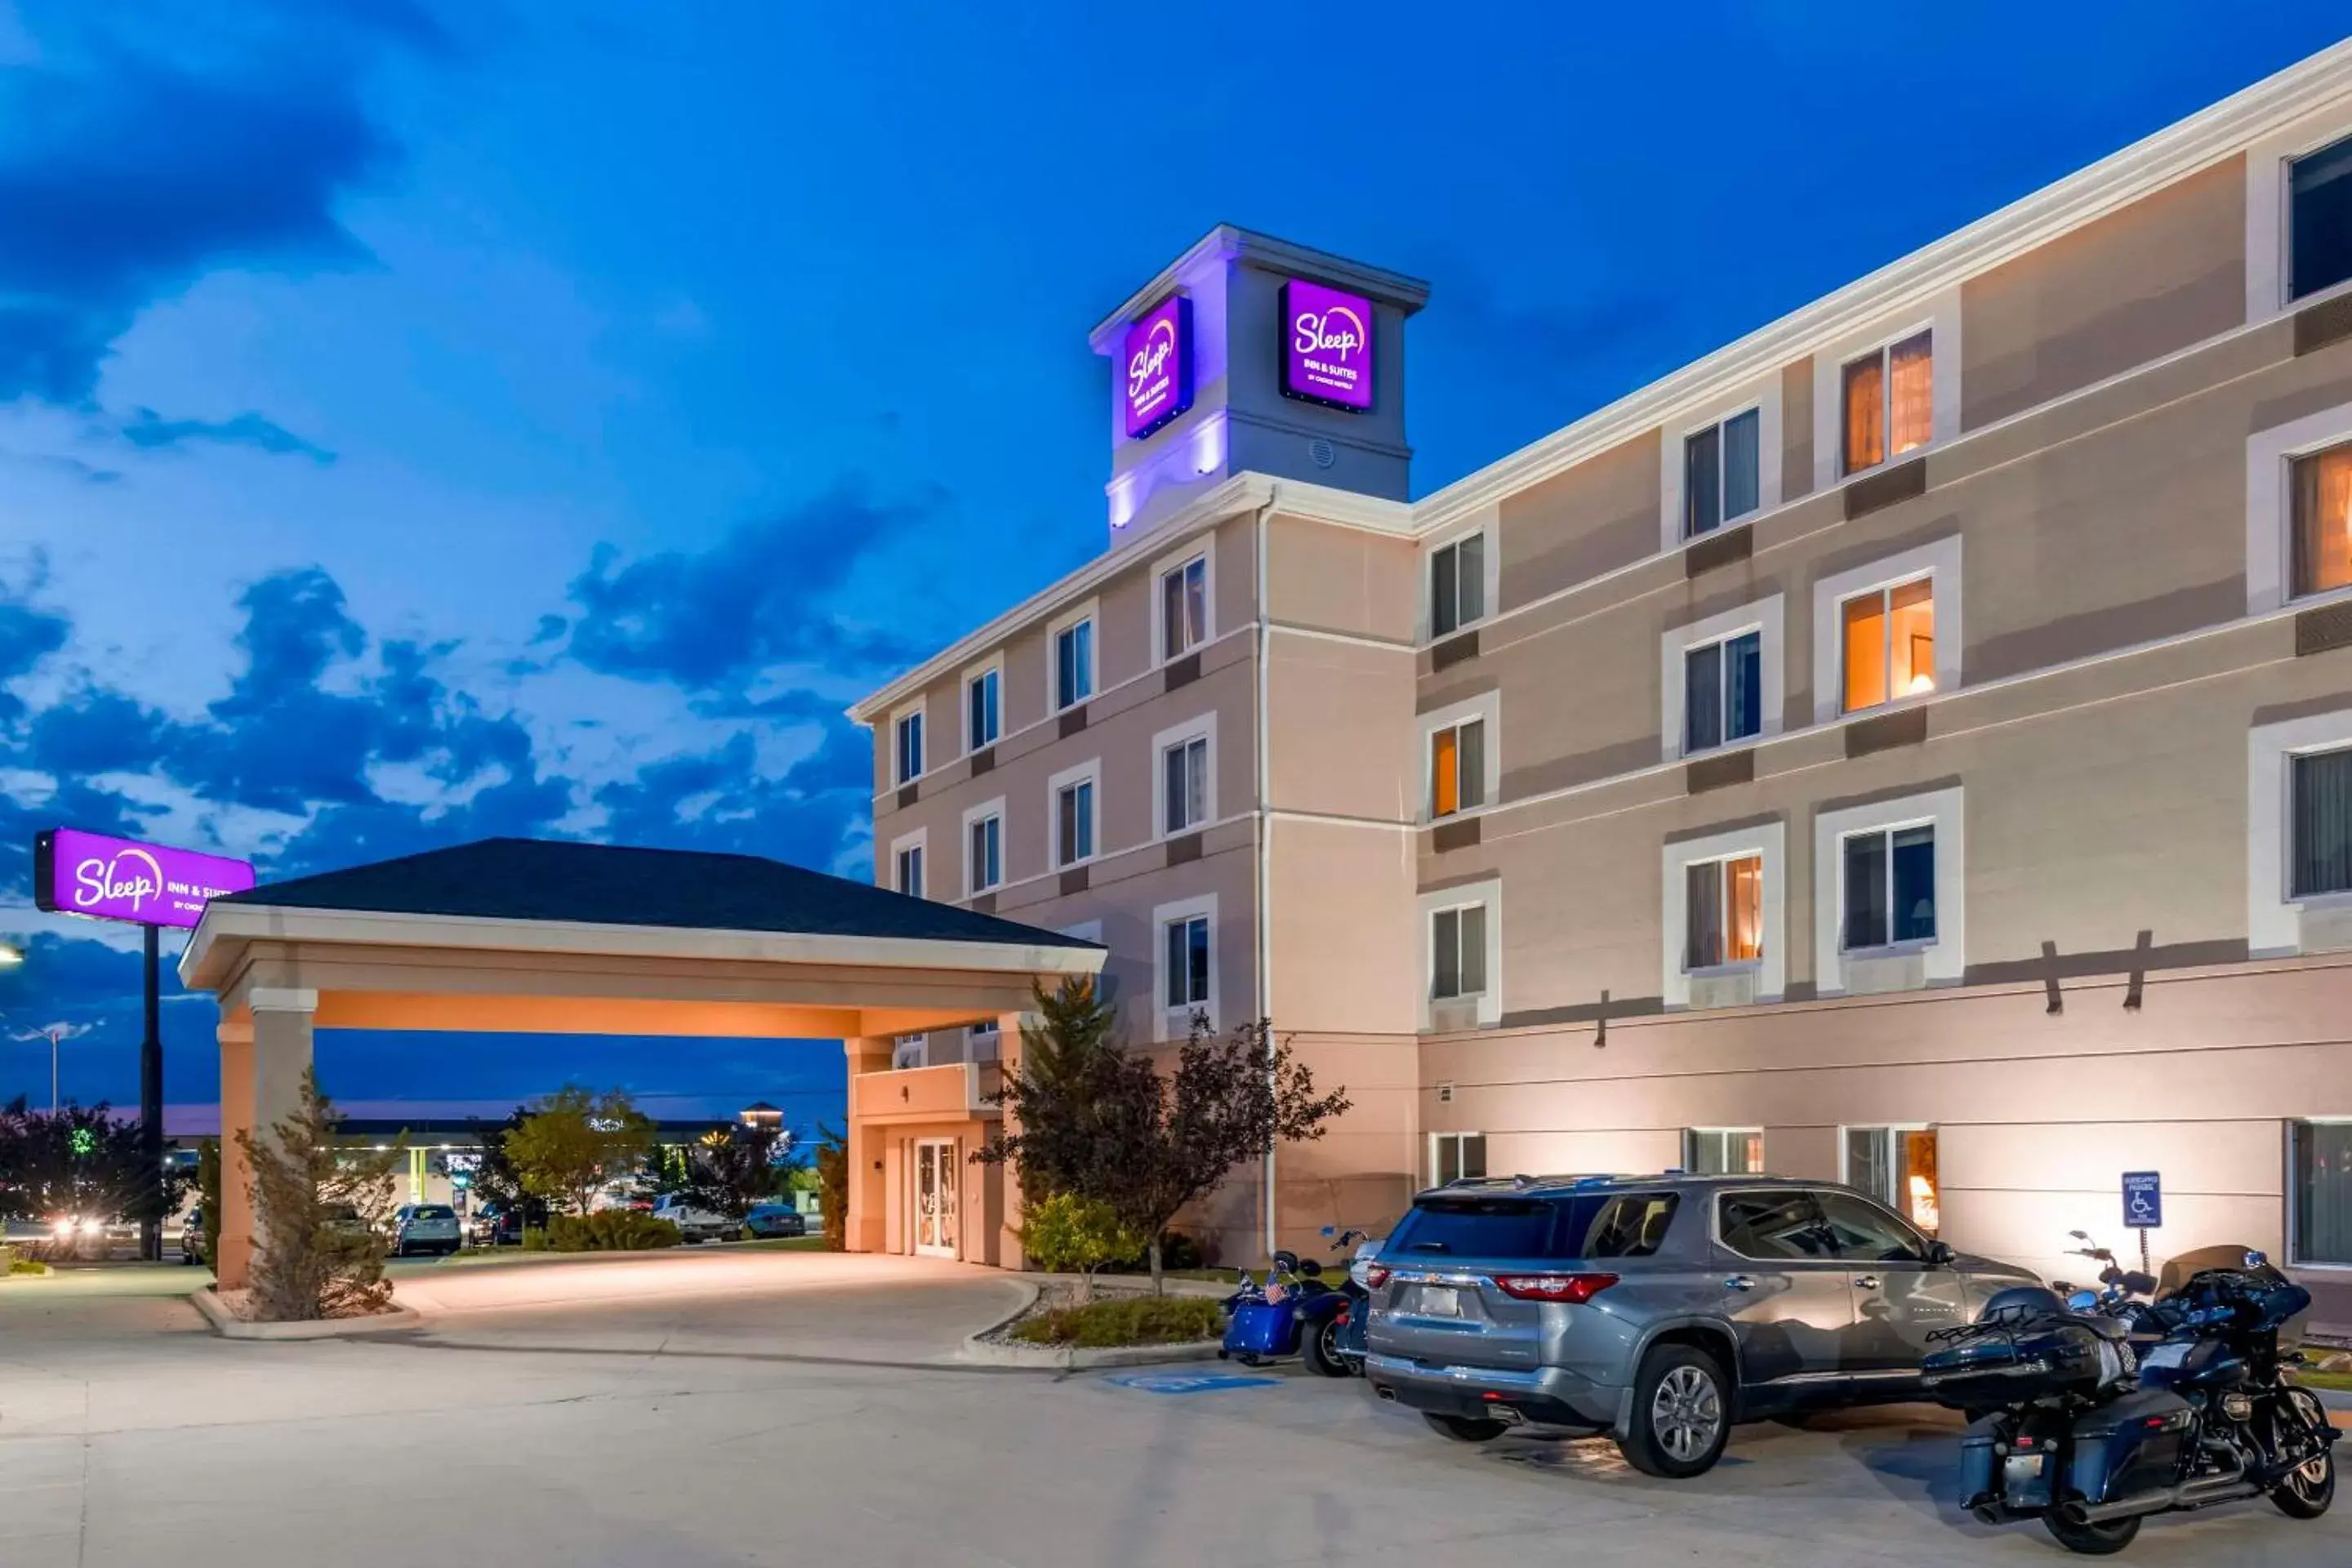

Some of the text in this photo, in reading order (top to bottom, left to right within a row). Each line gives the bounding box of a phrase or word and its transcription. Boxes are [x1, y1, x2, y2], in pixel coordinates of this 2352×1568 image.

[1295, 313, 1358, 362] Sleep
[1129, 341, 1169, 397] Sleep
[1329, 365, 1357, 381] SUITES
[75, 858, 154, 912] Sleep
[167, 882, 189, 896] INN
[192, 885, 200, 897] &
